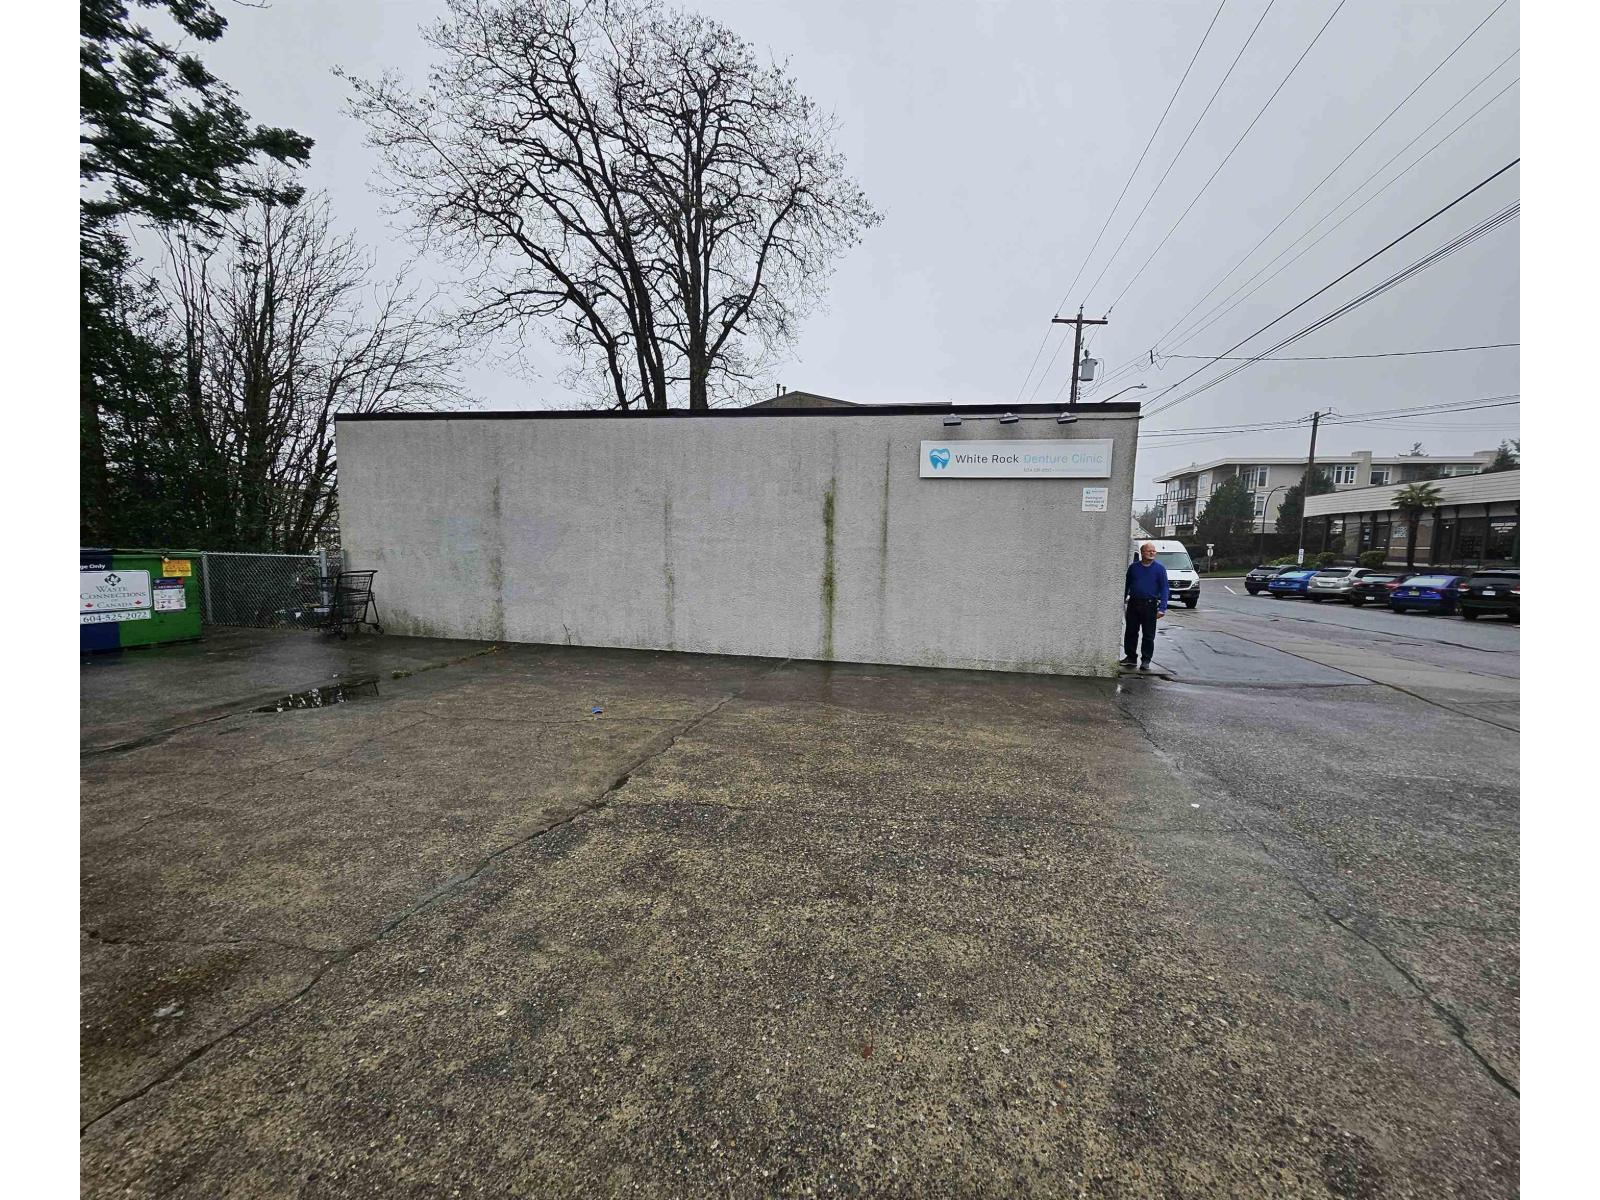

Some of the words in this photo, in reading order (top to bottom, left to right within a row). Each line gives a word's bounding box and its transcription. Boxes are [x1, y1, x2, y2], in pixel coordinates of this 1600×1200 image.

[955, 454, 988, 464] White
[992, 454, 1019, 464] Rock
[1023, 454, 1068, 464] Denture
[1072, 453, 1103, 464] Clinic
[83, 611, 147, 623] 604-525-2072
